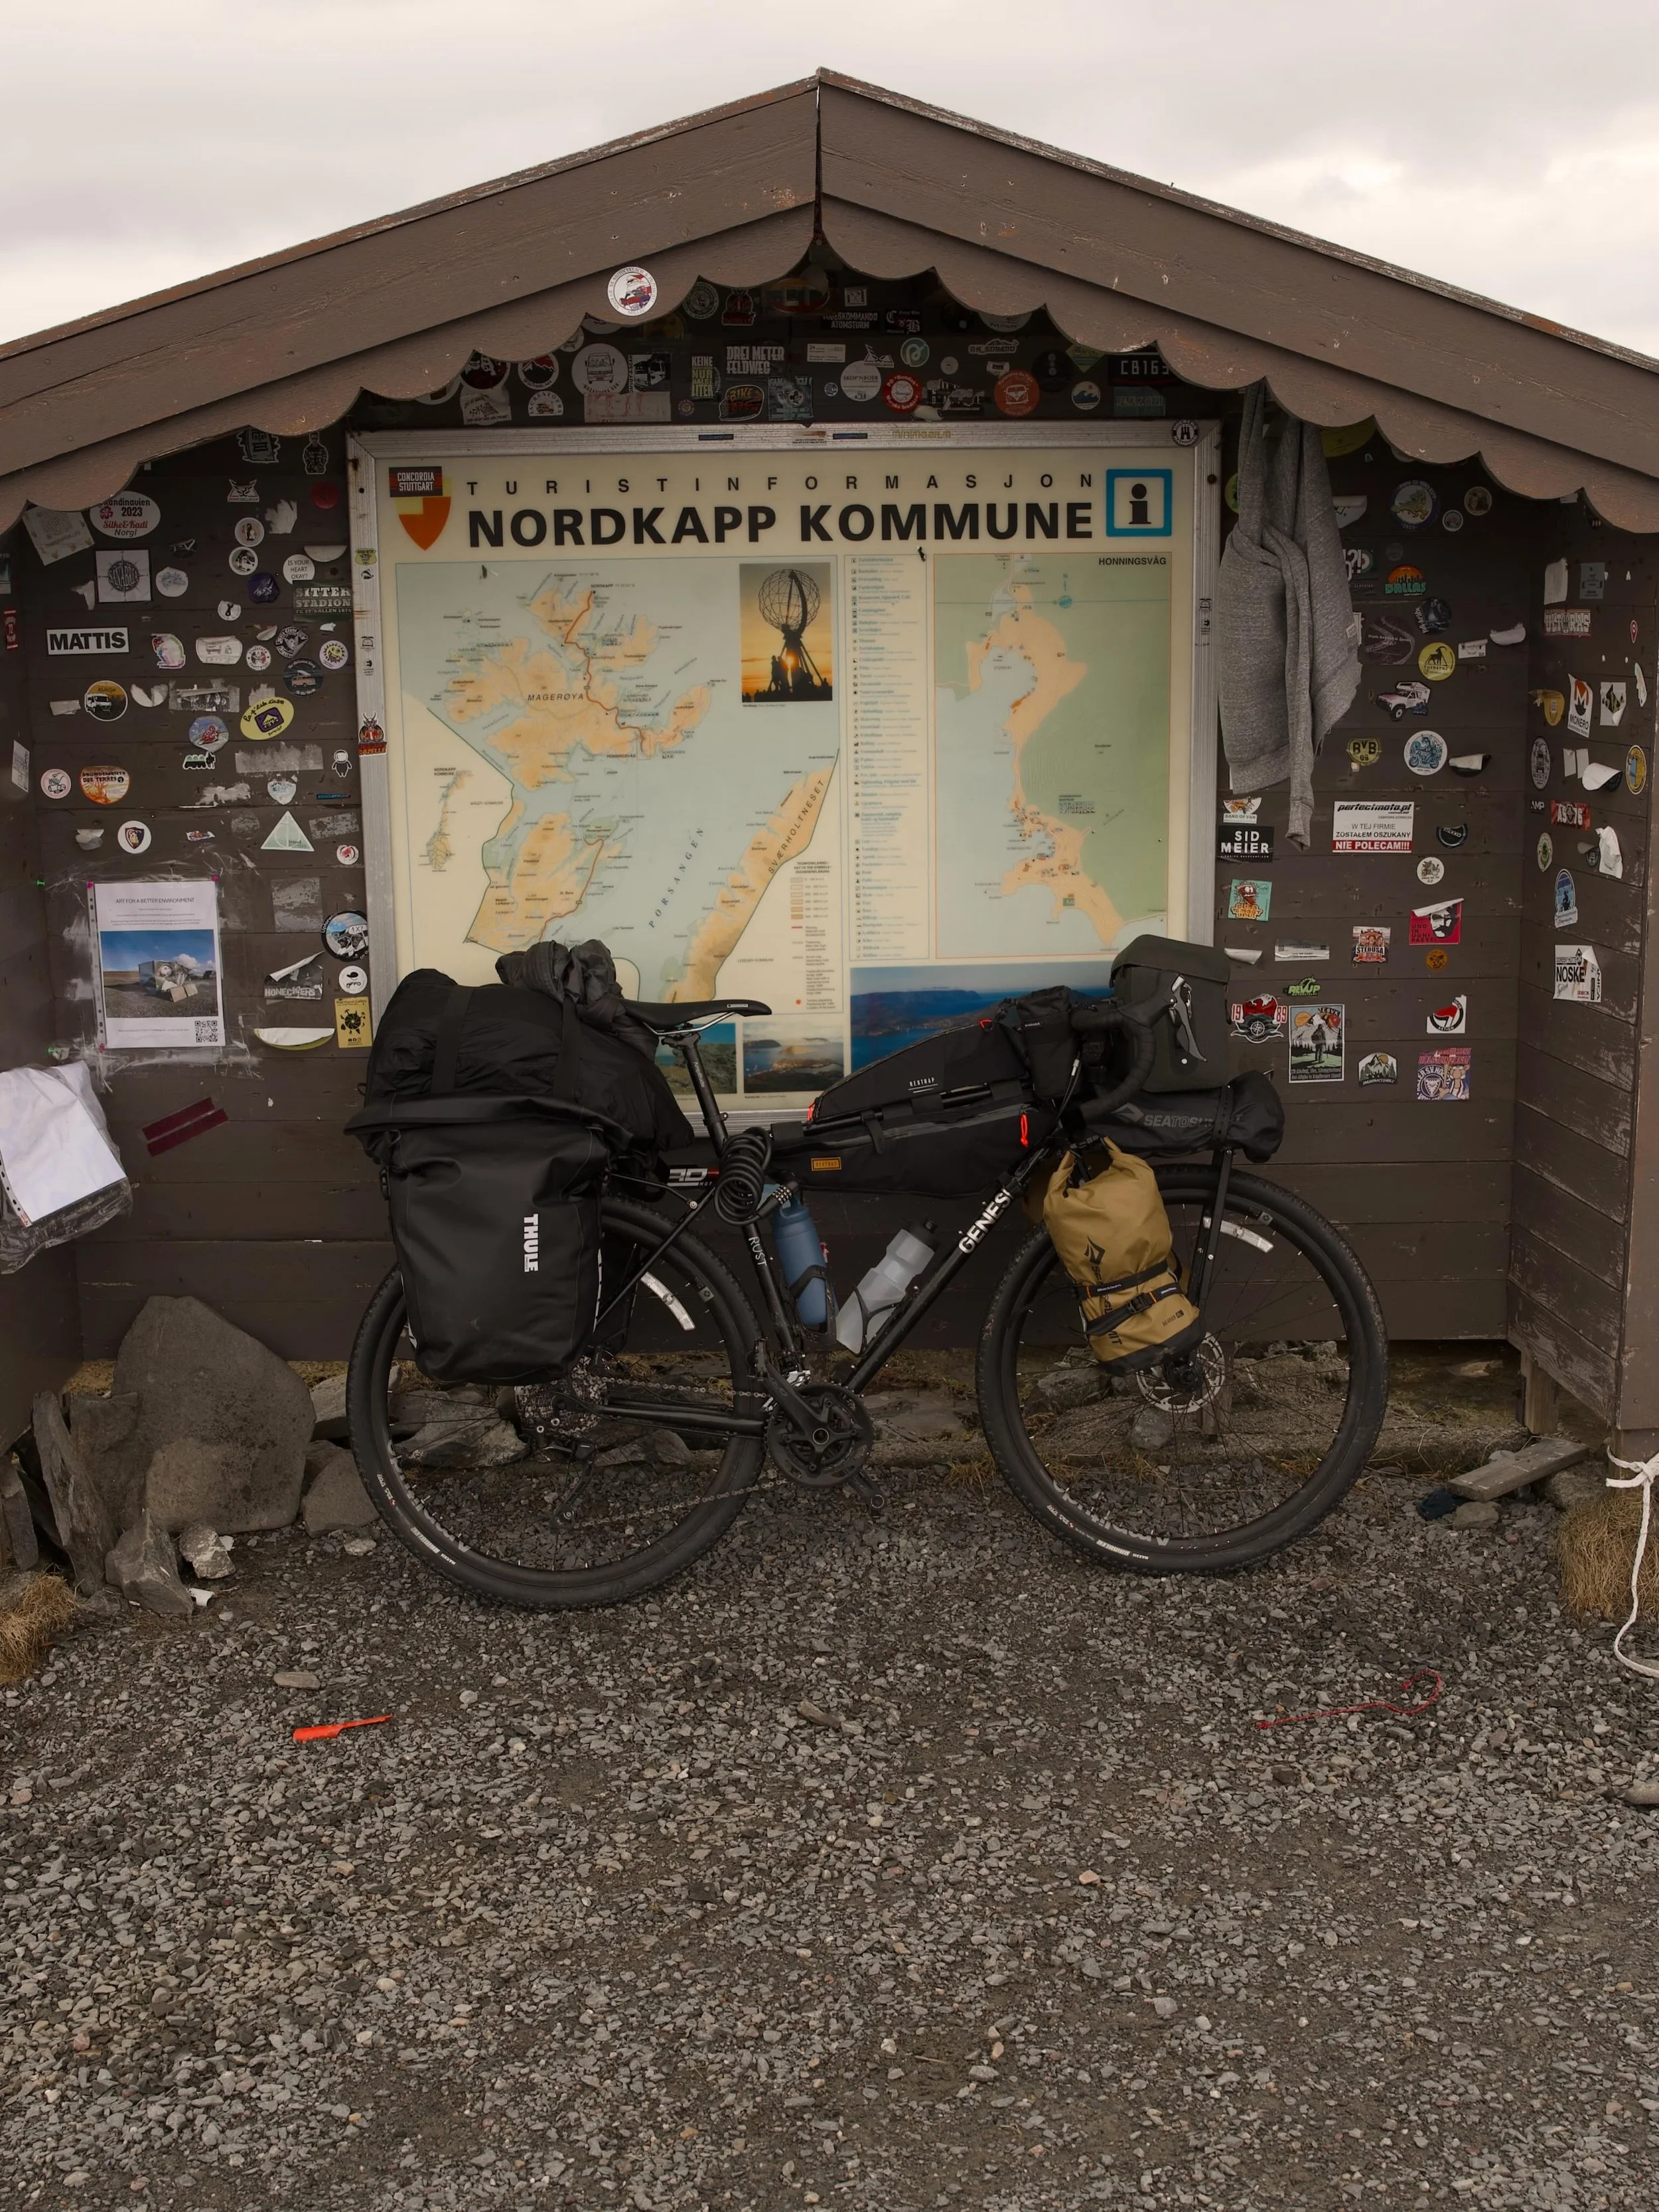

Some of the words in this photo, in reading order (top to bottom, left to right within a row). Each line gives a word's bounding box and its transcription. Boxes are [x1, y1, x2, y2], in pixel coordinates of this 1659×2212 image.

[726, 346, 750, 361] DREI
[752, 346, 785, 361] METER
[691, 356, 713, 366] KEINE
[727, 360, 771, 375] FELDWEG
[691, 369, 713, 379] NUR
[397, 471, 435, 482] CONCORDIA
[399, 482, 434, 492] STUTTGART
[467, 473, 1092, 496] TURISTINFORMASJON
[121, 506, 143, 517] 2023
[468, 505, 777, 548] NORDKAPP
[800, 502, 1093, 543] KOMMUNE
[1098, 556, 1167, 567] HONNINGSVÅG
[1384, 581, 1427, 595] DALLAS
[296, 598, 352, 608] STADION
[49, 631, 127, 651] MATTIS
[528, 693, 585, 702] MAGERØYA
[1569, 713, 1589, 731] MONERO
[1352, 741, 1377, 755] BVB
[768, 778, 825, 875] SVÆRHOLTNESET
[1234, 830, 1260, 842] SID
[1220, 842, 1269, 854] MEIER
[1335, 841, 1352, 850] NIE
[1356, 841, 1409, 851] POLECAM!!!
[648, 826, 704, 929] PORSANGEN
[1556, 966, 1585, 983] NOSKE
[1232, 1004, 1242, 1021] 19
[1276, 1005, 1287, 1022] 89
[908, 1076, 936, 1088] RESTRAP
[958, 1188, 1014, 1254] GENESI
[523, 1213, 539, 1273] THULE
[748, 1236, 768, 1267] RUST
[1096, 1283, 1122, 1293] Blackburn
